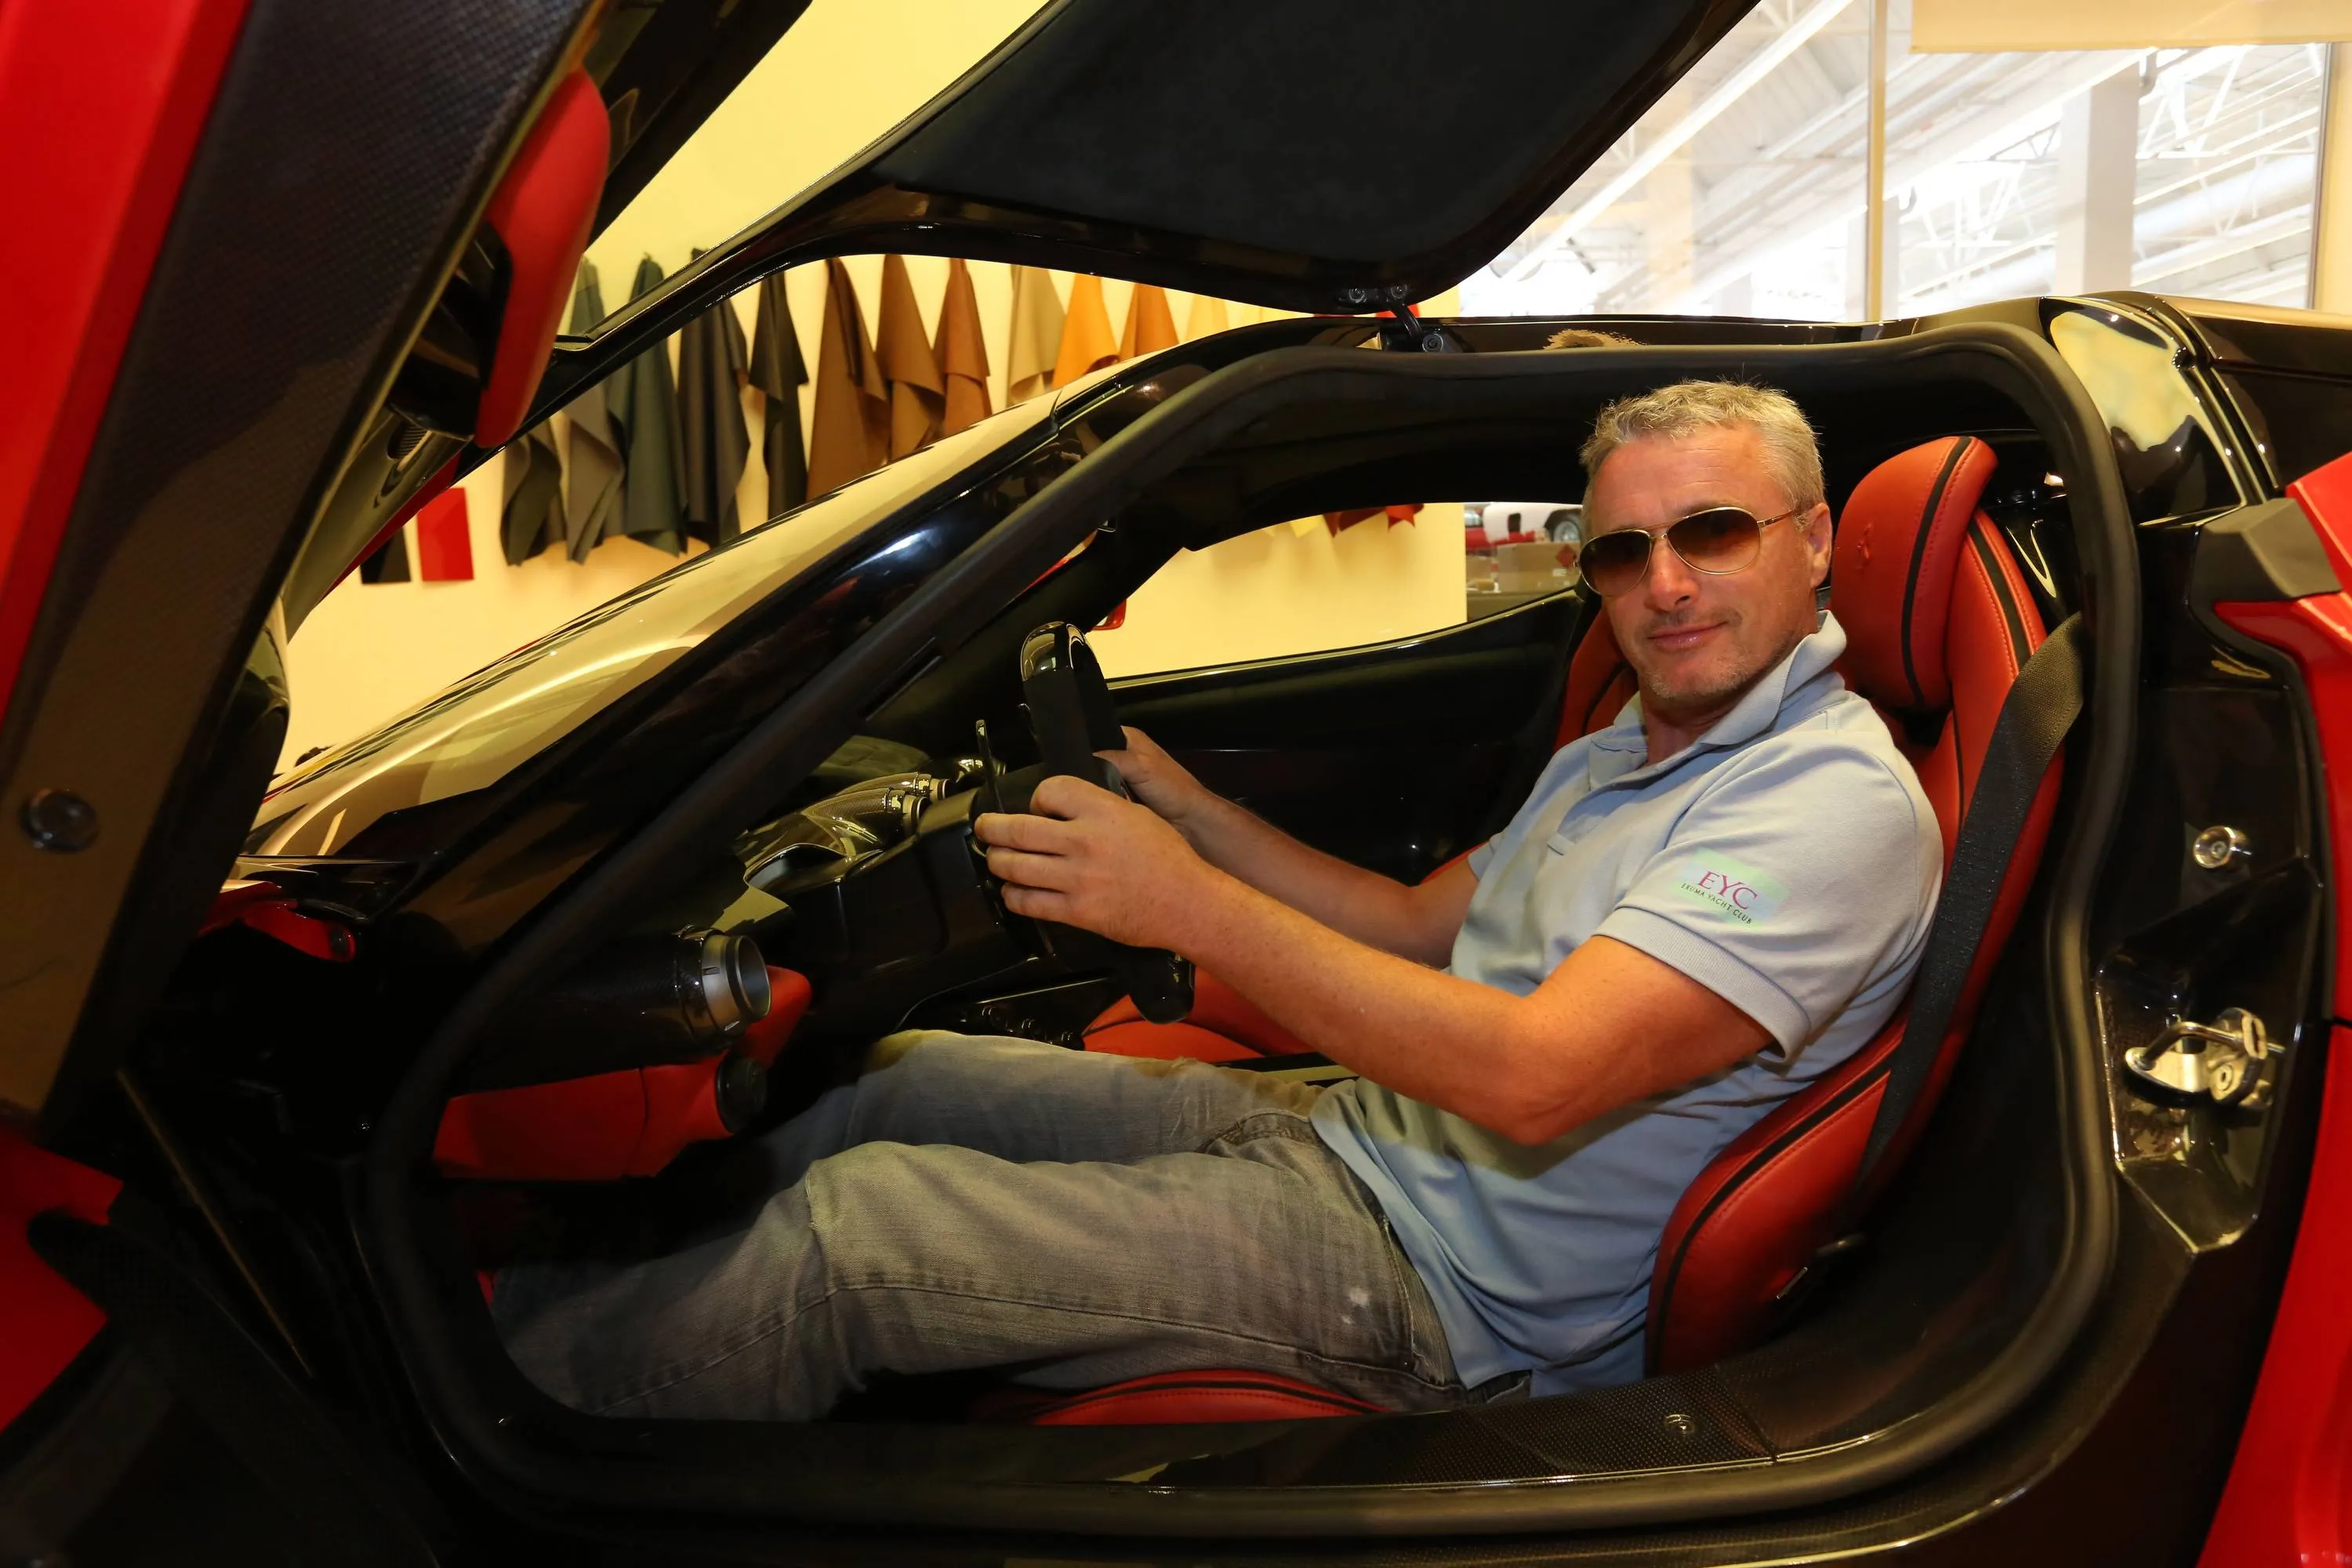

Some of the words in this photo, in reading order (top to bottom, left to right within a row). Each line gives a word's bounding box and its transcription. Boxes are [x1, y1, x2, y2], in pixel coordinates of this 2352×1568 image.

[1697, 871, 1758, 909] EYC
[1708, 894, 1733, 911] YACHT
[1733, 909, 1752, 924] CLUB
